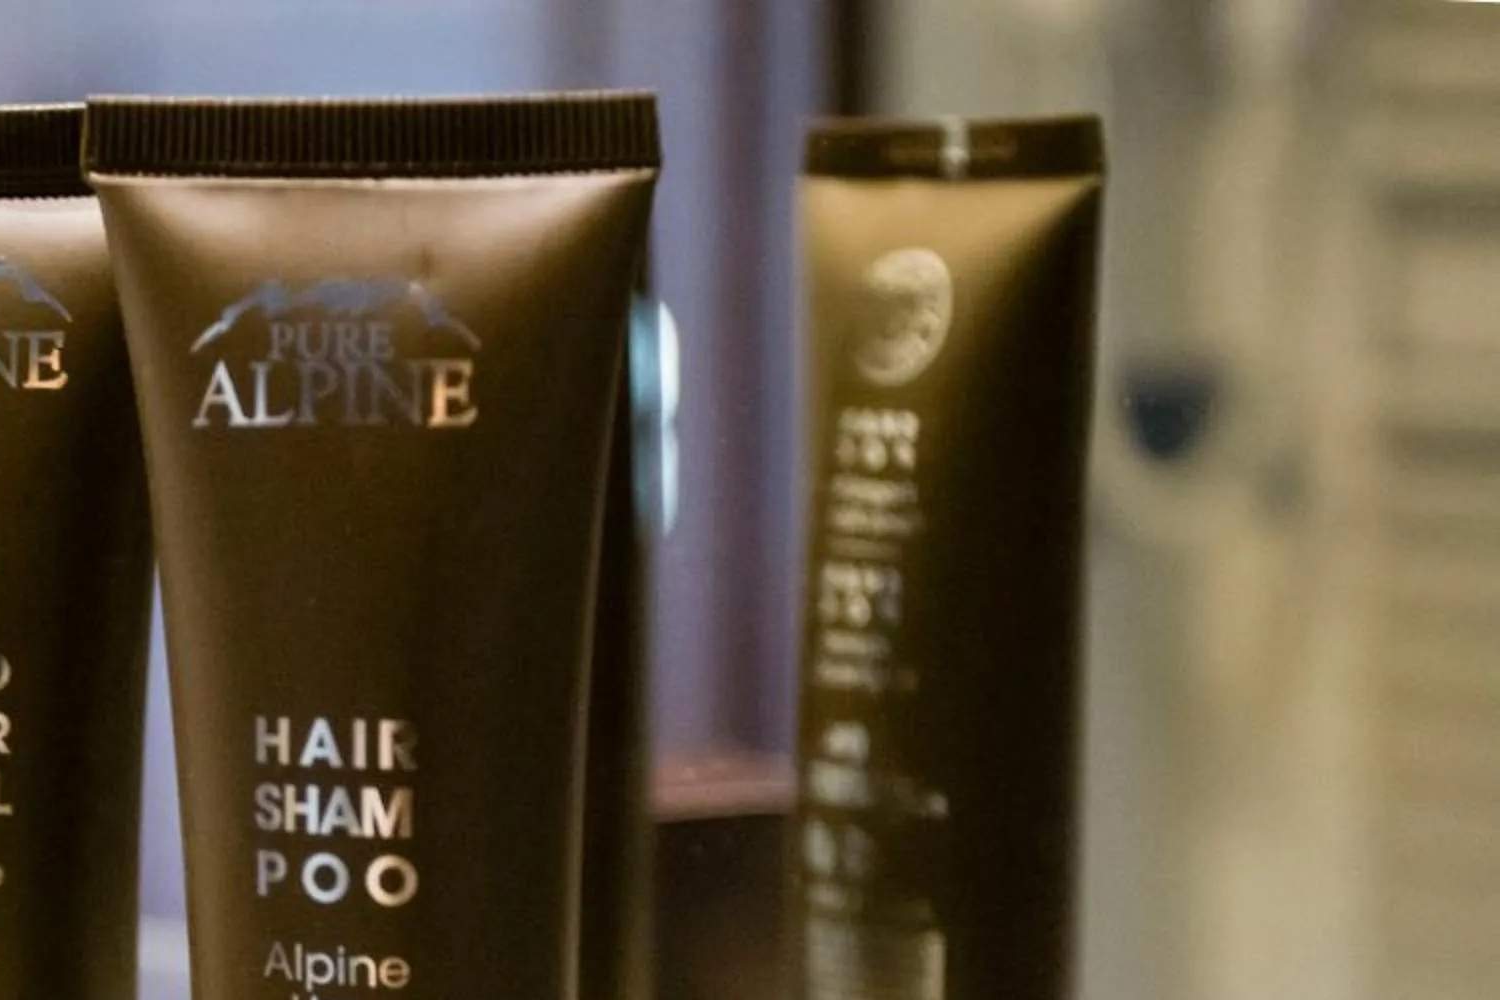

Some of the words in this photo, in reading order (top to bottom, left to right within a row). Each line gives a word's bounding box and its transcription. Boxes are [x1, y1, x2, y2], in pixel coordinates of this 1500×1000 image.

[267, 322, 395, 360] PURE
[193, 358, 479, 429] ALPINE
[254, 714, 419, 771] HAIR
[253, 782, 416, 840] SHAM
[255, 849, 419, 908] POO
[263, 941, 411, 991] Alpine
